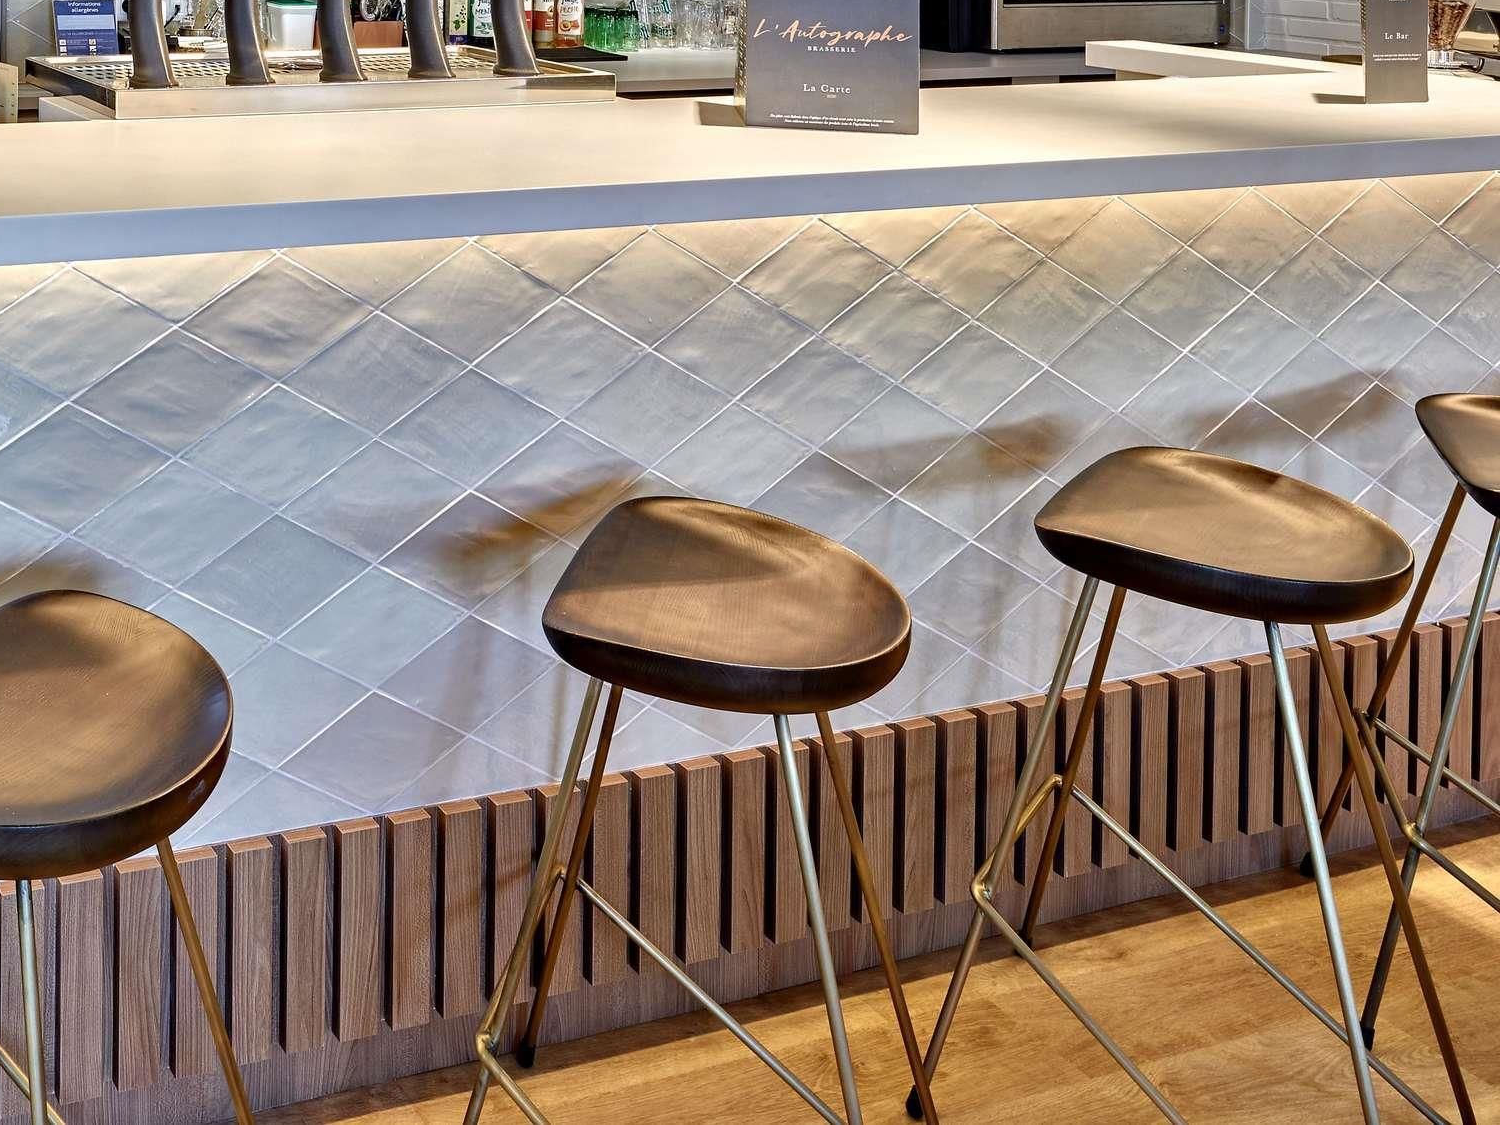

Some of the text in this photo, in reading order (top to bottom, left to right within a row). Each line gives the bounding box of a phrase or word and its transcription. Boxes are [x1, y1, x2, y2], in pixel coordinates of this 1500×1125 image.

[752, 18, 913, 49] L'Autographe
[1396, 32, 1409, 40] Bar
[807, 45, 856, 53] BRASSERIE
[803, 83, 851, 94] La Carte
